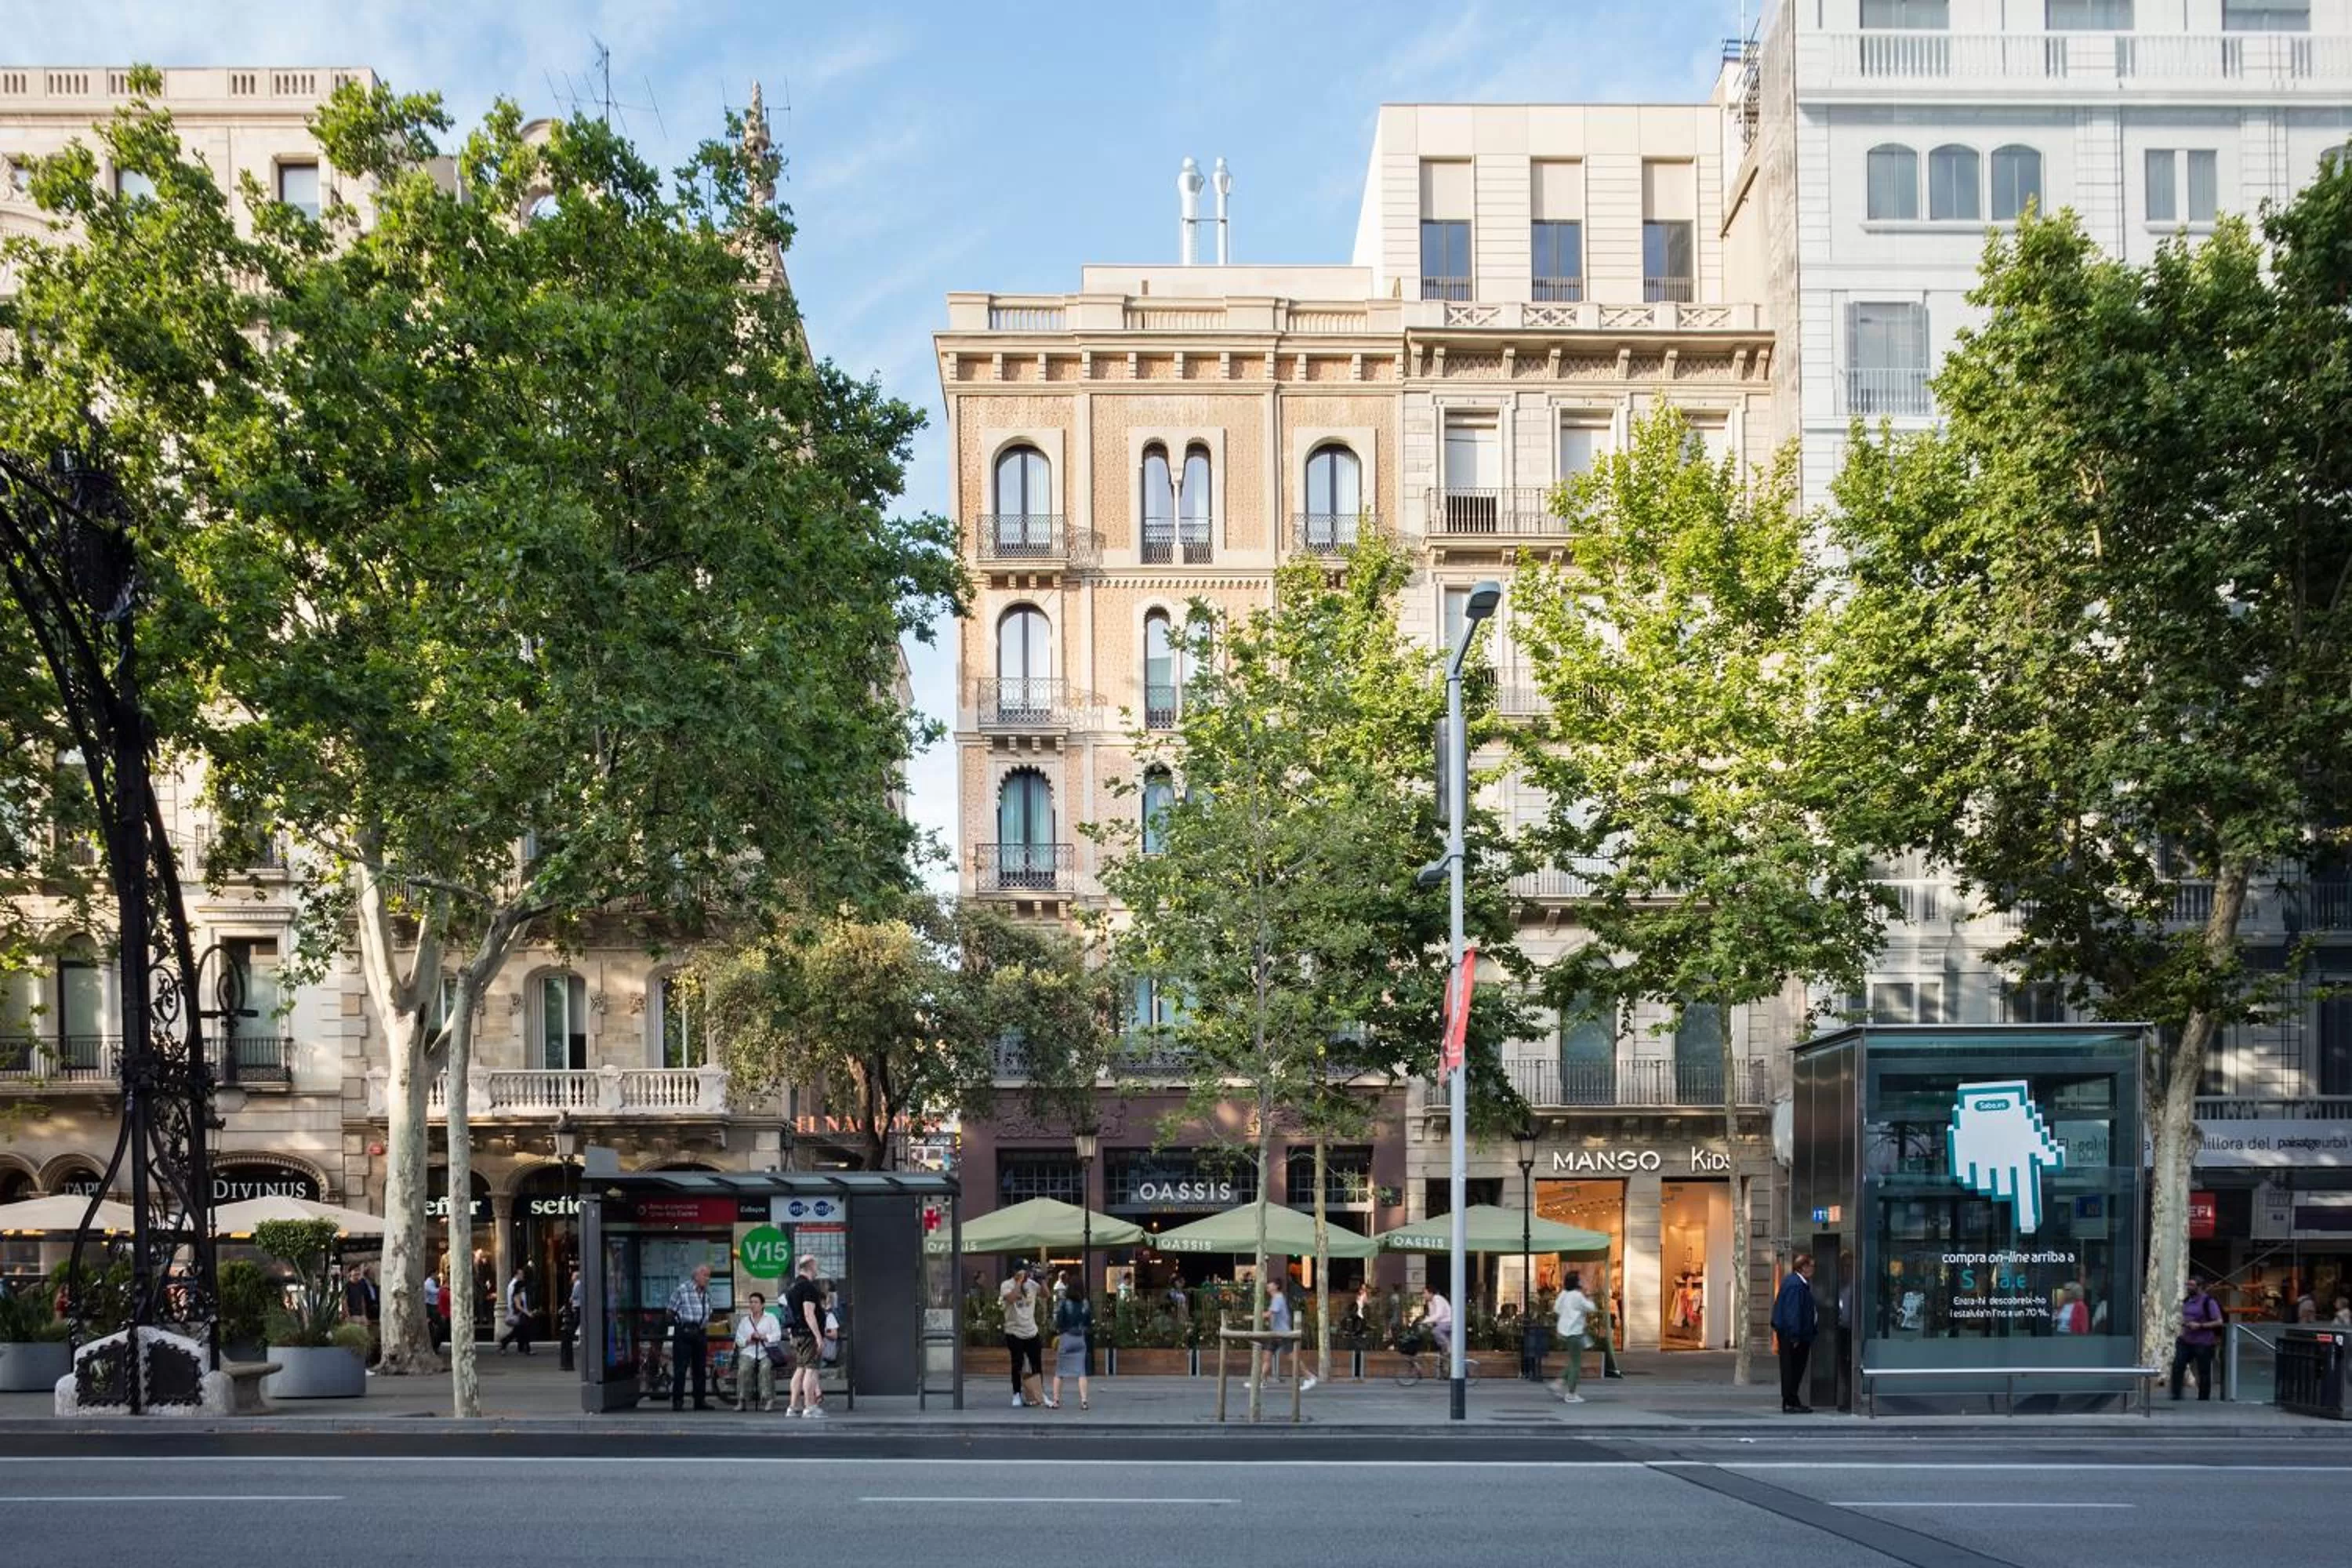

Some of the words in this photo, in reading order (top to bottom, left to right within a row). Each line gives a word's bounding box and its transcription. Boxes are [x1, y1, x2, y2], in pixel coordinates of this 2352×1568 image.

[2248, 1135, 2270, 1150] del
[1552, 1150, 1661, 1171] MANGO
[1139, 1181, 1231, 1201] OASSIS
[927, 1241, 978, 1253] OAIS
[1161, 1238, 1212, 1250] OASSIS
[1395, 1236, 1444, 1249] OASSIS
[746, 1241, 788, 1262] V15
[1942, 1253, 1986, 1267] compra
[1987, 1250, 2030, 1263] on-line
[2031, 1250, 2067, 1263] arriba
[2067, 1252, 2076, 1263] a
